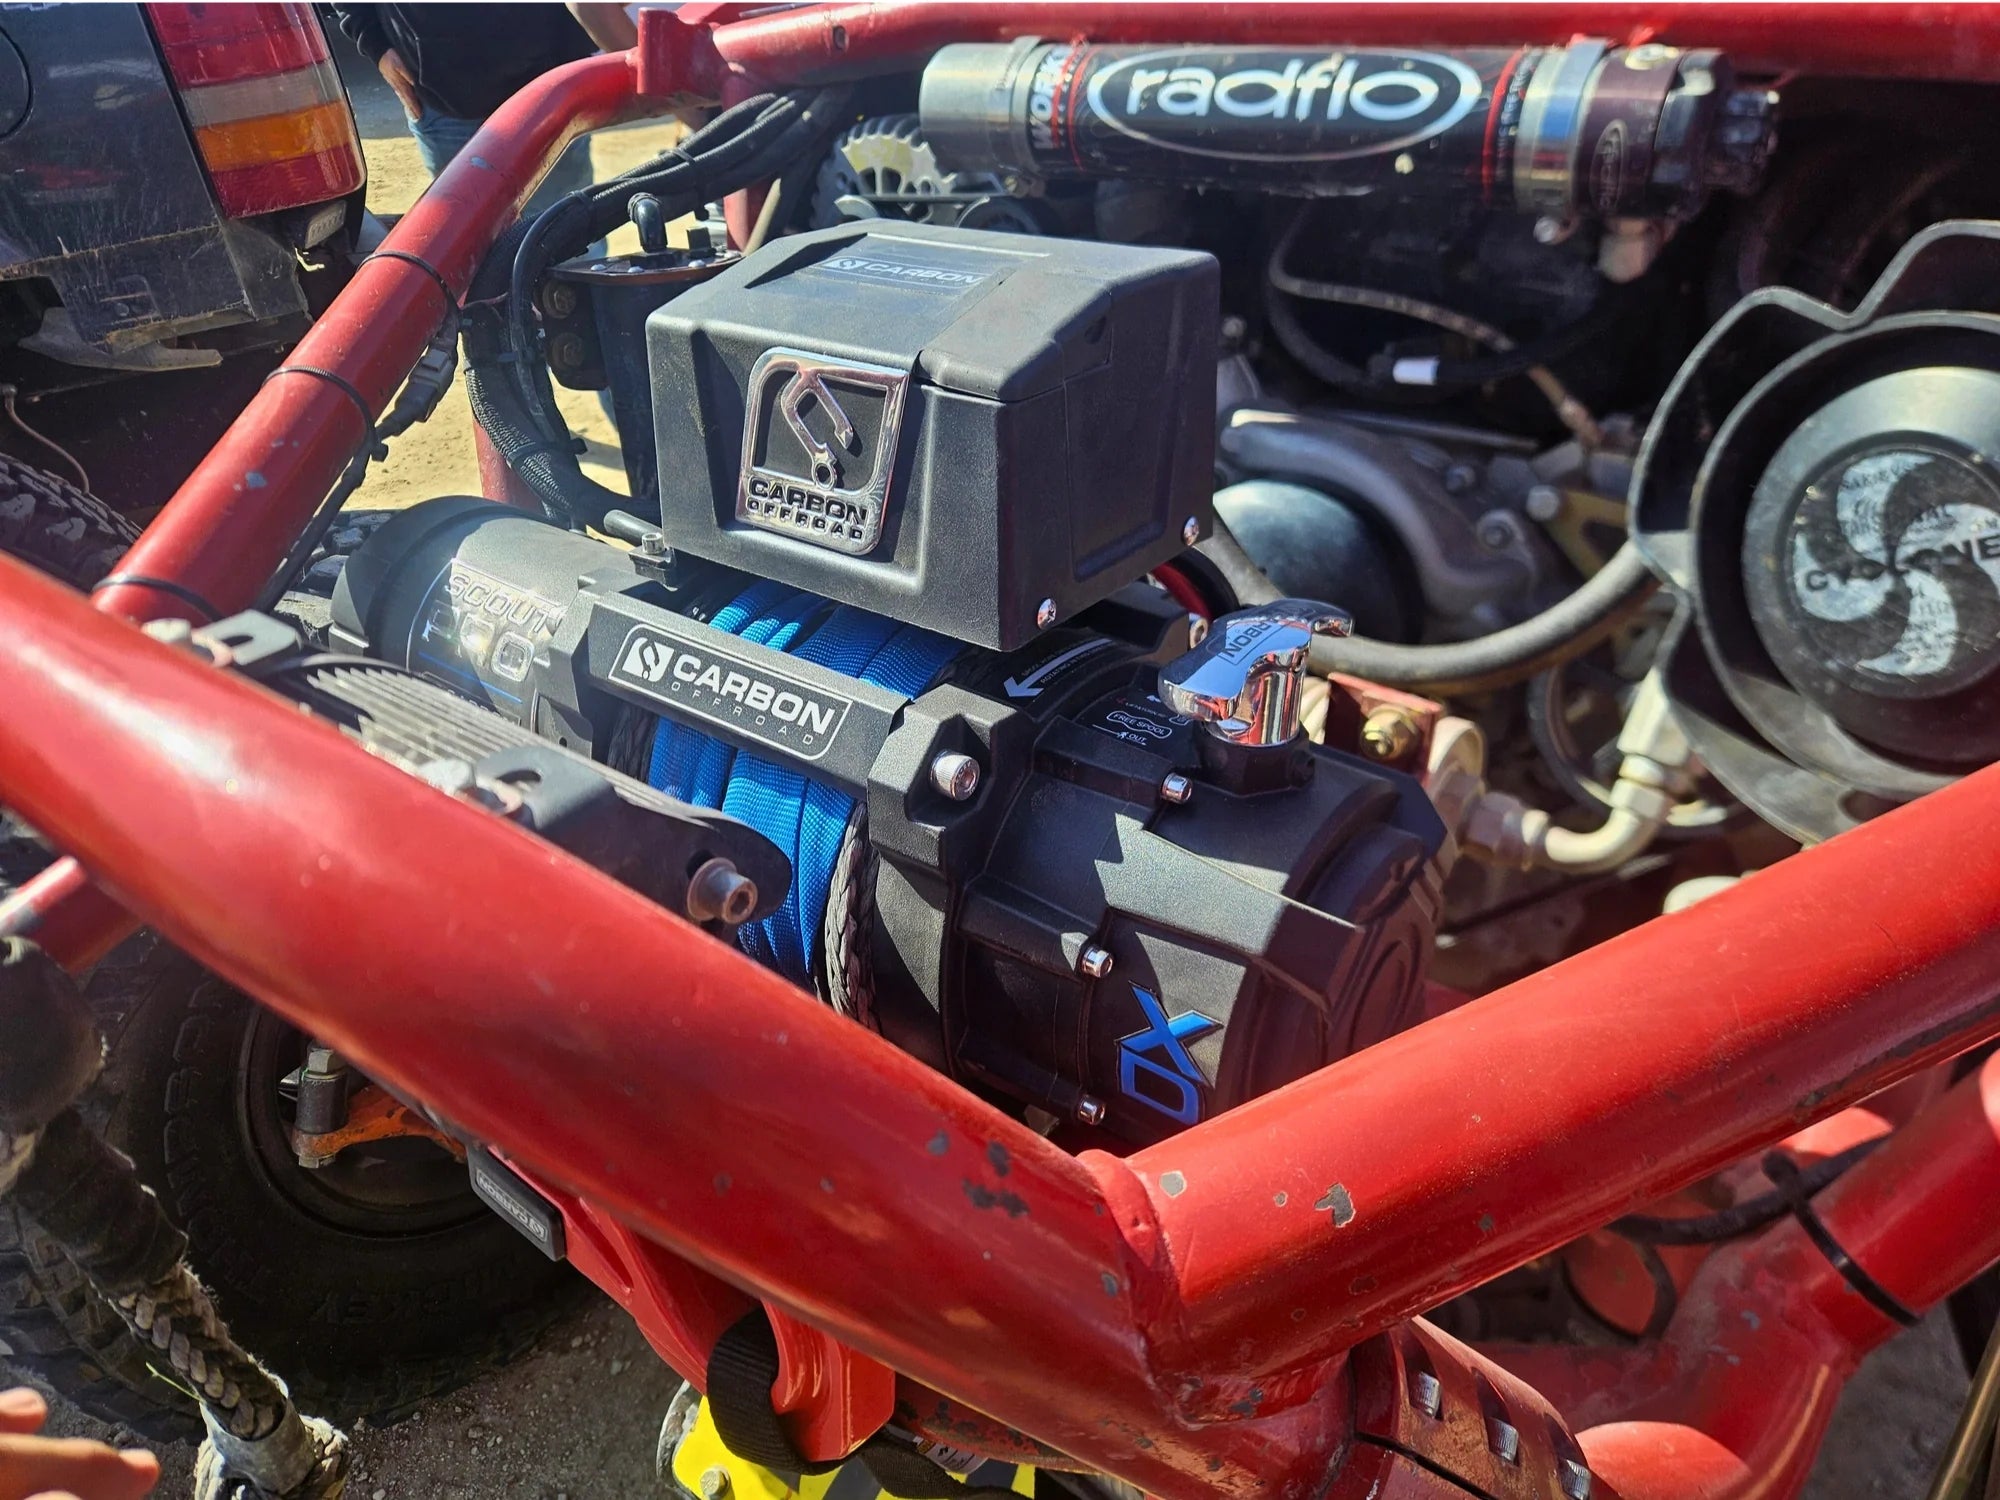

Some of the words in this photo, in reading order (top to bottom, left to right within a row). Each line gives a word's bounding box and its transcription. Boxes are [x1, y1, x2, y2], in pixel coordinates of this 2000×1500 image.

[1126, 56, 1440, 121] radflo
[864, 262, 985, 284] CARBON
[747, 499, 863, 540] OFFROAD
[749, 478, 868, 523] CARBON
[445, 573, 562, 634] SCOUT
[671, 681, 814, 745] OFFROAD
[673, 653, 836, 735] CARBON
[1112, 711, 1138, 726] FREE
[1135, 720, 1166, 736] SPOOL
[1128, 733, 1148, 743] OUT
[479, 1176, 529, 1225] CARBON
